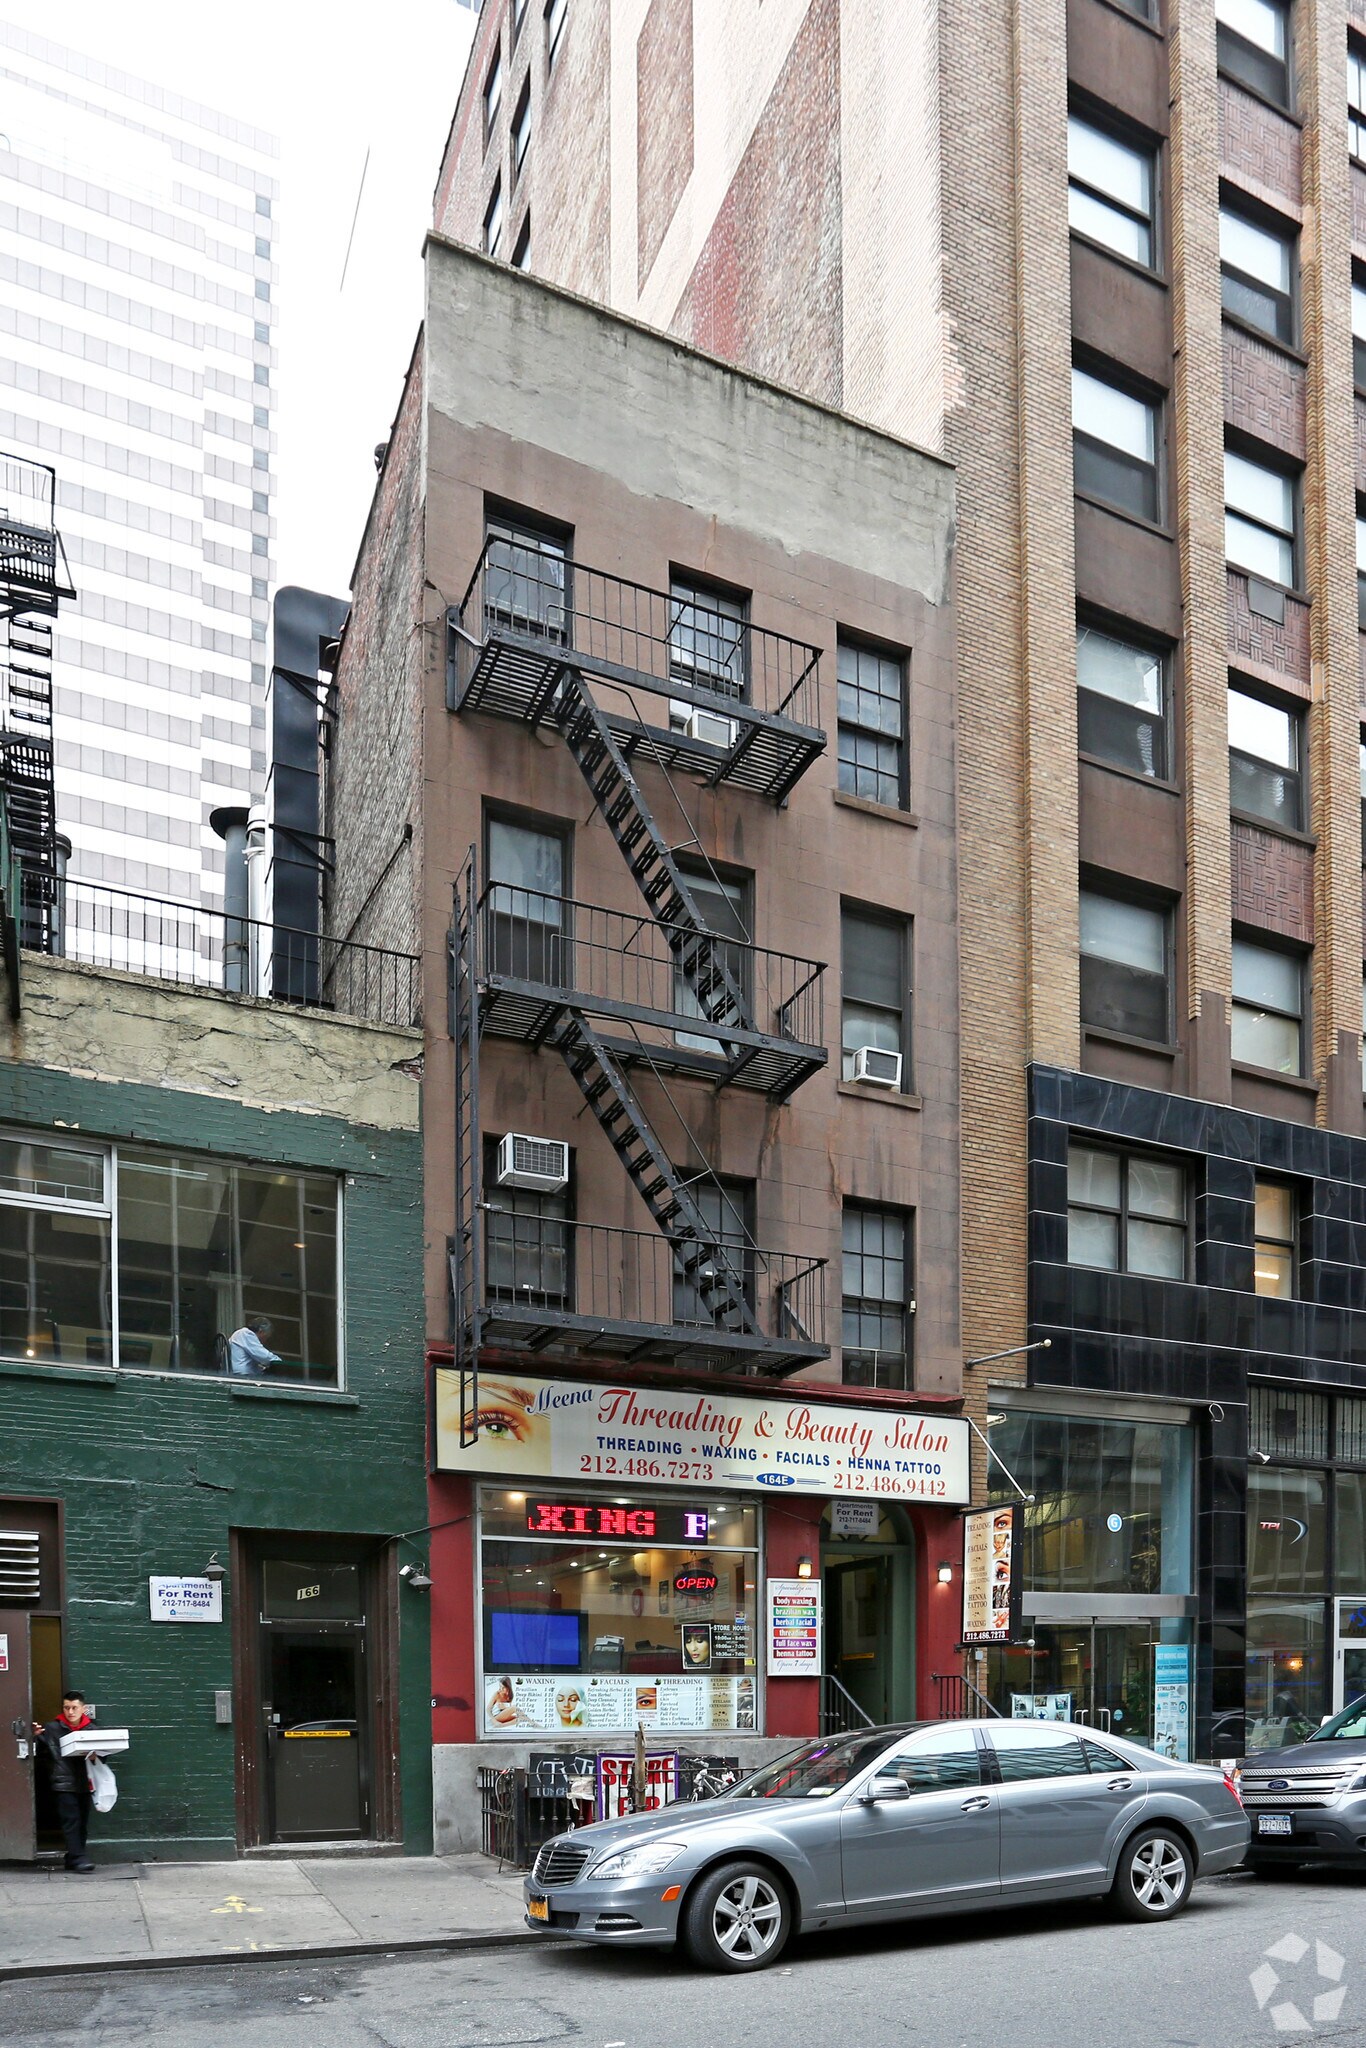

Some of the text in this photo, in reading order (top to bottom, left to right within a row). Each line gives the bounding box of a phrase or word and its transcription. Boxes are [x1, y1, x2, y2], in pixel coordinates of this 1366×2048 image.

[527, 1386, 594, 1413] Meena
[597, 1389, 949, 1458] Threading & Beauty Salon
[596, 1436, 941, 1475] THREADING WAXING FACIALS HENNA TATTOO
[579, 1455, 714, 1481] 212.486.7273
[762, 1475, 789, 1485] 164E
[833, 1473, 946, 1496] 212.486.9442
[528, 1505, 655, 1536] XING
[967, 1543, 988, 1553] FACIALS
[676, 1577, 715, 1589] OPEN
[776, 1597, 812, 1606] body waxing
[968, 1593, 986, 1601] HENNA
[967, 1601, 987, 1609] TATTOO
[966, 1619, 986, 1628] WAXING
[779, 1629, 808, 1637] threading
[430, 1698, 437, 1707] 6
[602, 1758, 673, 1785] STRE
[618, 1796, 660, 1816] FR
